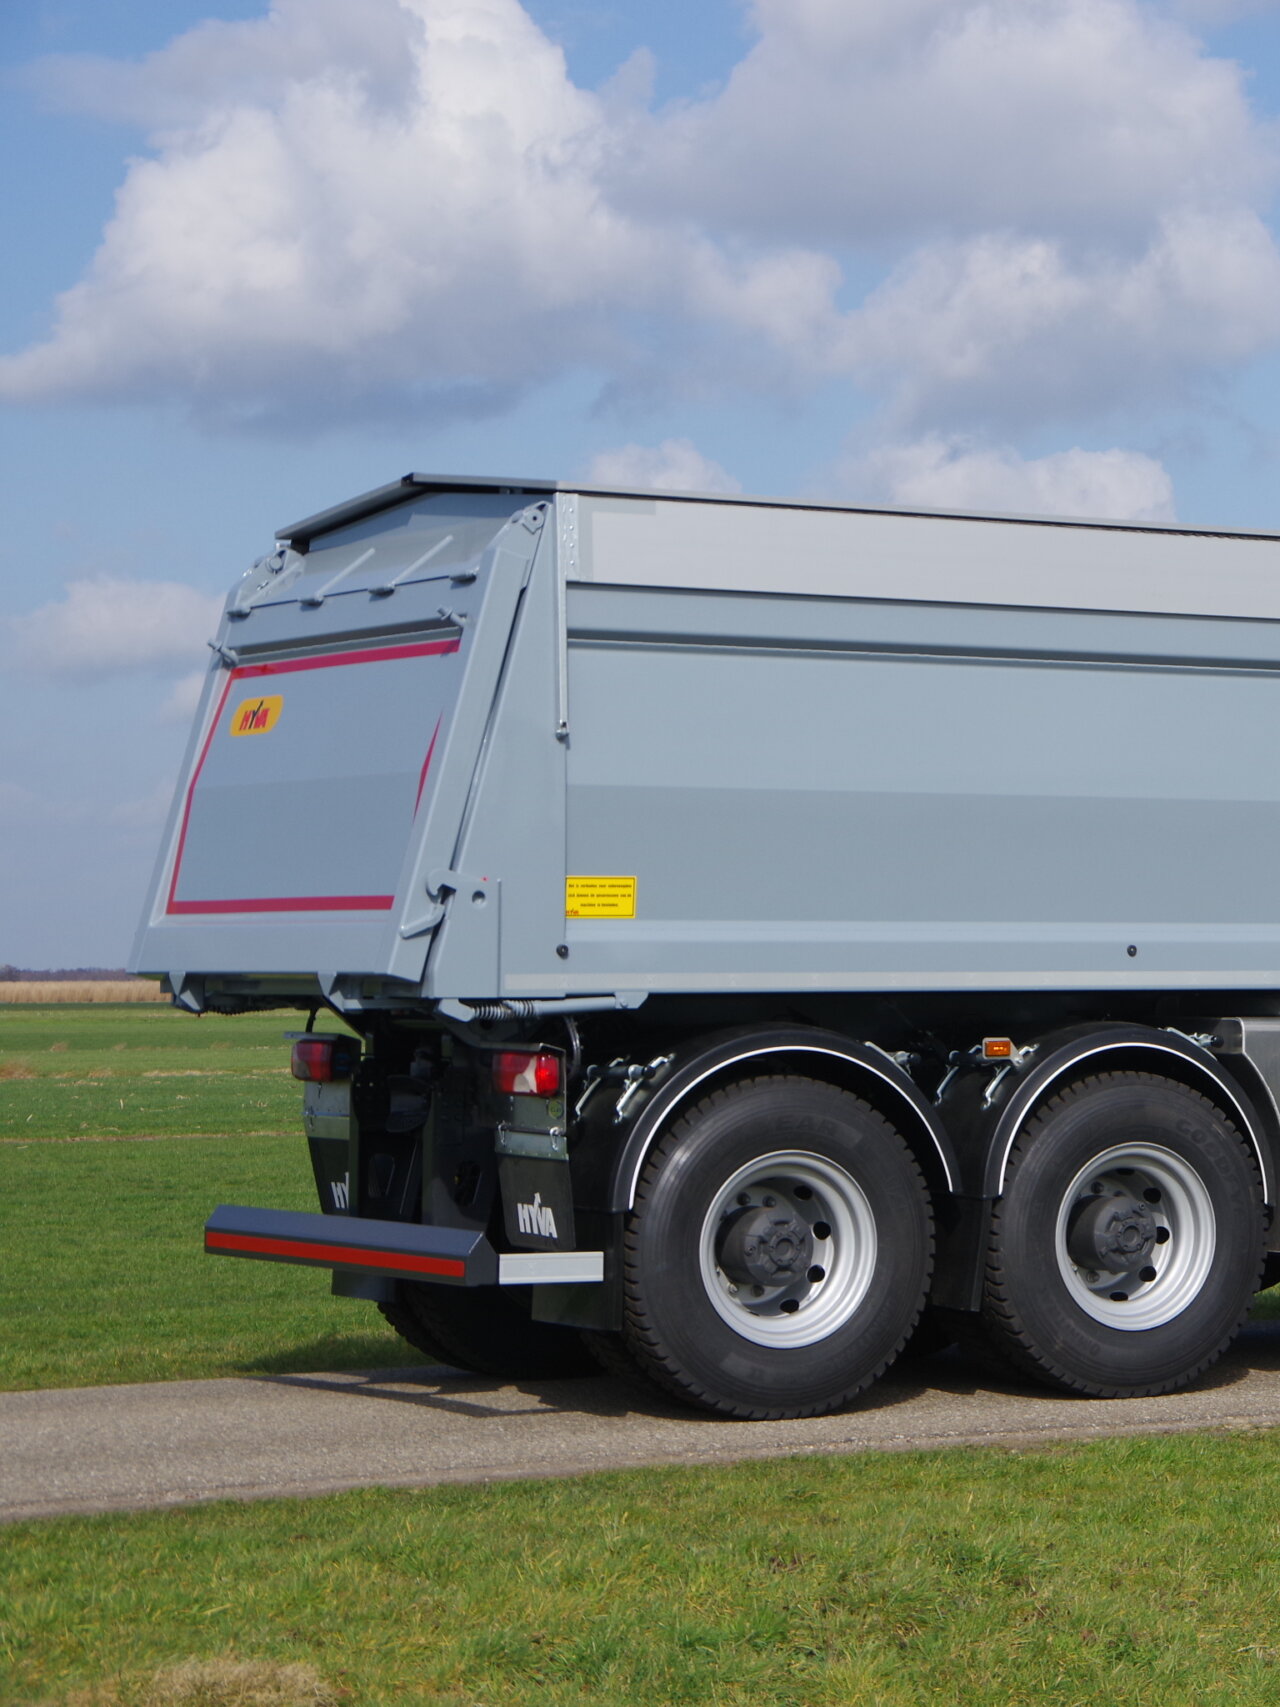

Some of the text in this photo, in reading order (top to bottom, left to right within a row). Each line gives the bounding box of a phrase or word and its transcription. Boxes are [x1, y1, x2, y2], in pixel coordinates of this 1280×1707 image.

[239, 699, 270, 731] HYVA
[331, 1172, 349, 1208] HY
[517, 1192, 558, 1239] HYVA
